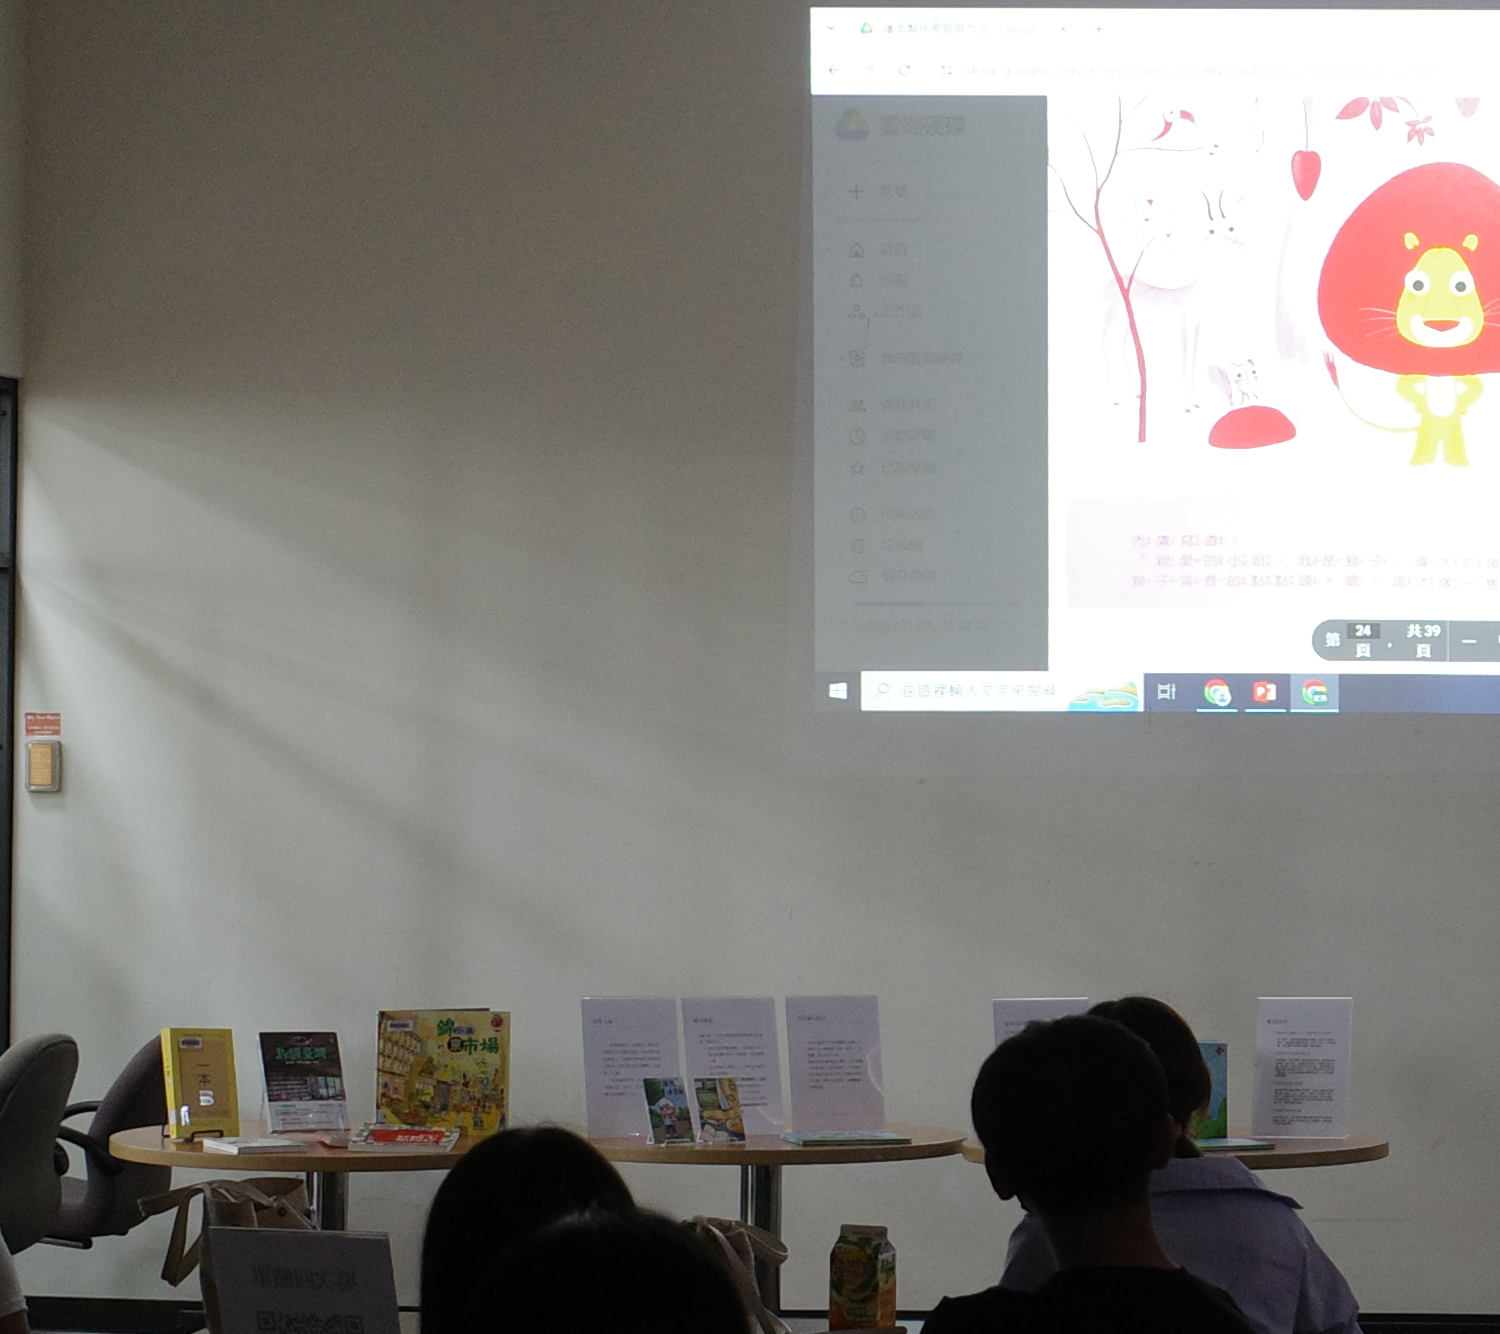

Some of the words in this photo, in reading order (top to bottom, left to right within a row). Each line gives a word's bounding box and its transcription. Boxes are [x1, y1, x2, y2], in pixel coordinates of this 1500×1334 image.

[1355, 624, 1372, 636] 24
[1325, 632, 1341, 647] 第
[1355, 643, 1371, 658] 頁
[1416, 643, 1432, 658] 頁
